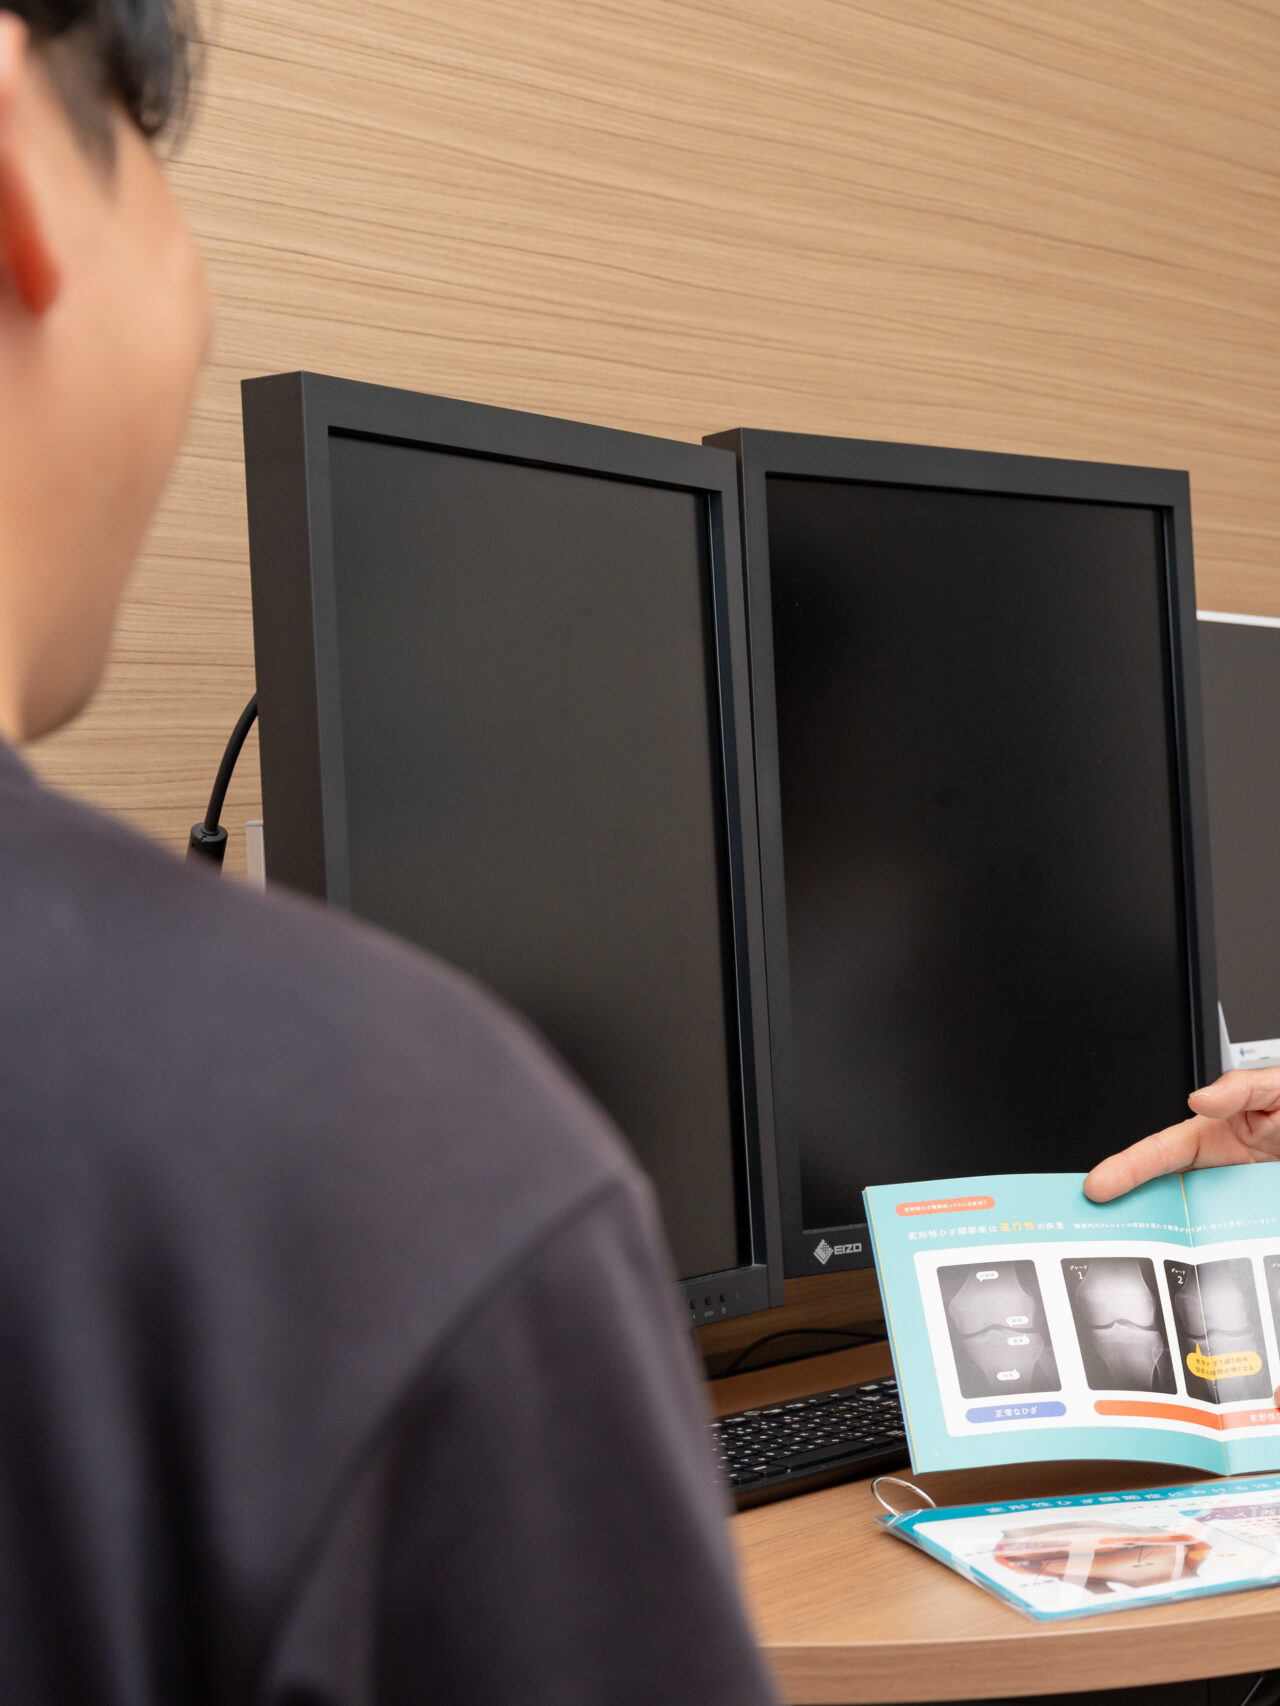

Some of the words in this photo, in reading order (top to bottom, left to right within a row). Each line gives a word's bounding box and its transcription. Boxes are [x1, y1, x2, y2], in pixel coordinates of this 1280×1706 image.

[834, 1243, 862, 1255] EIZO
[1177, 1275, 1184, 1284] 2
[994, 1406, 1038, 1418] 正常なひざ
